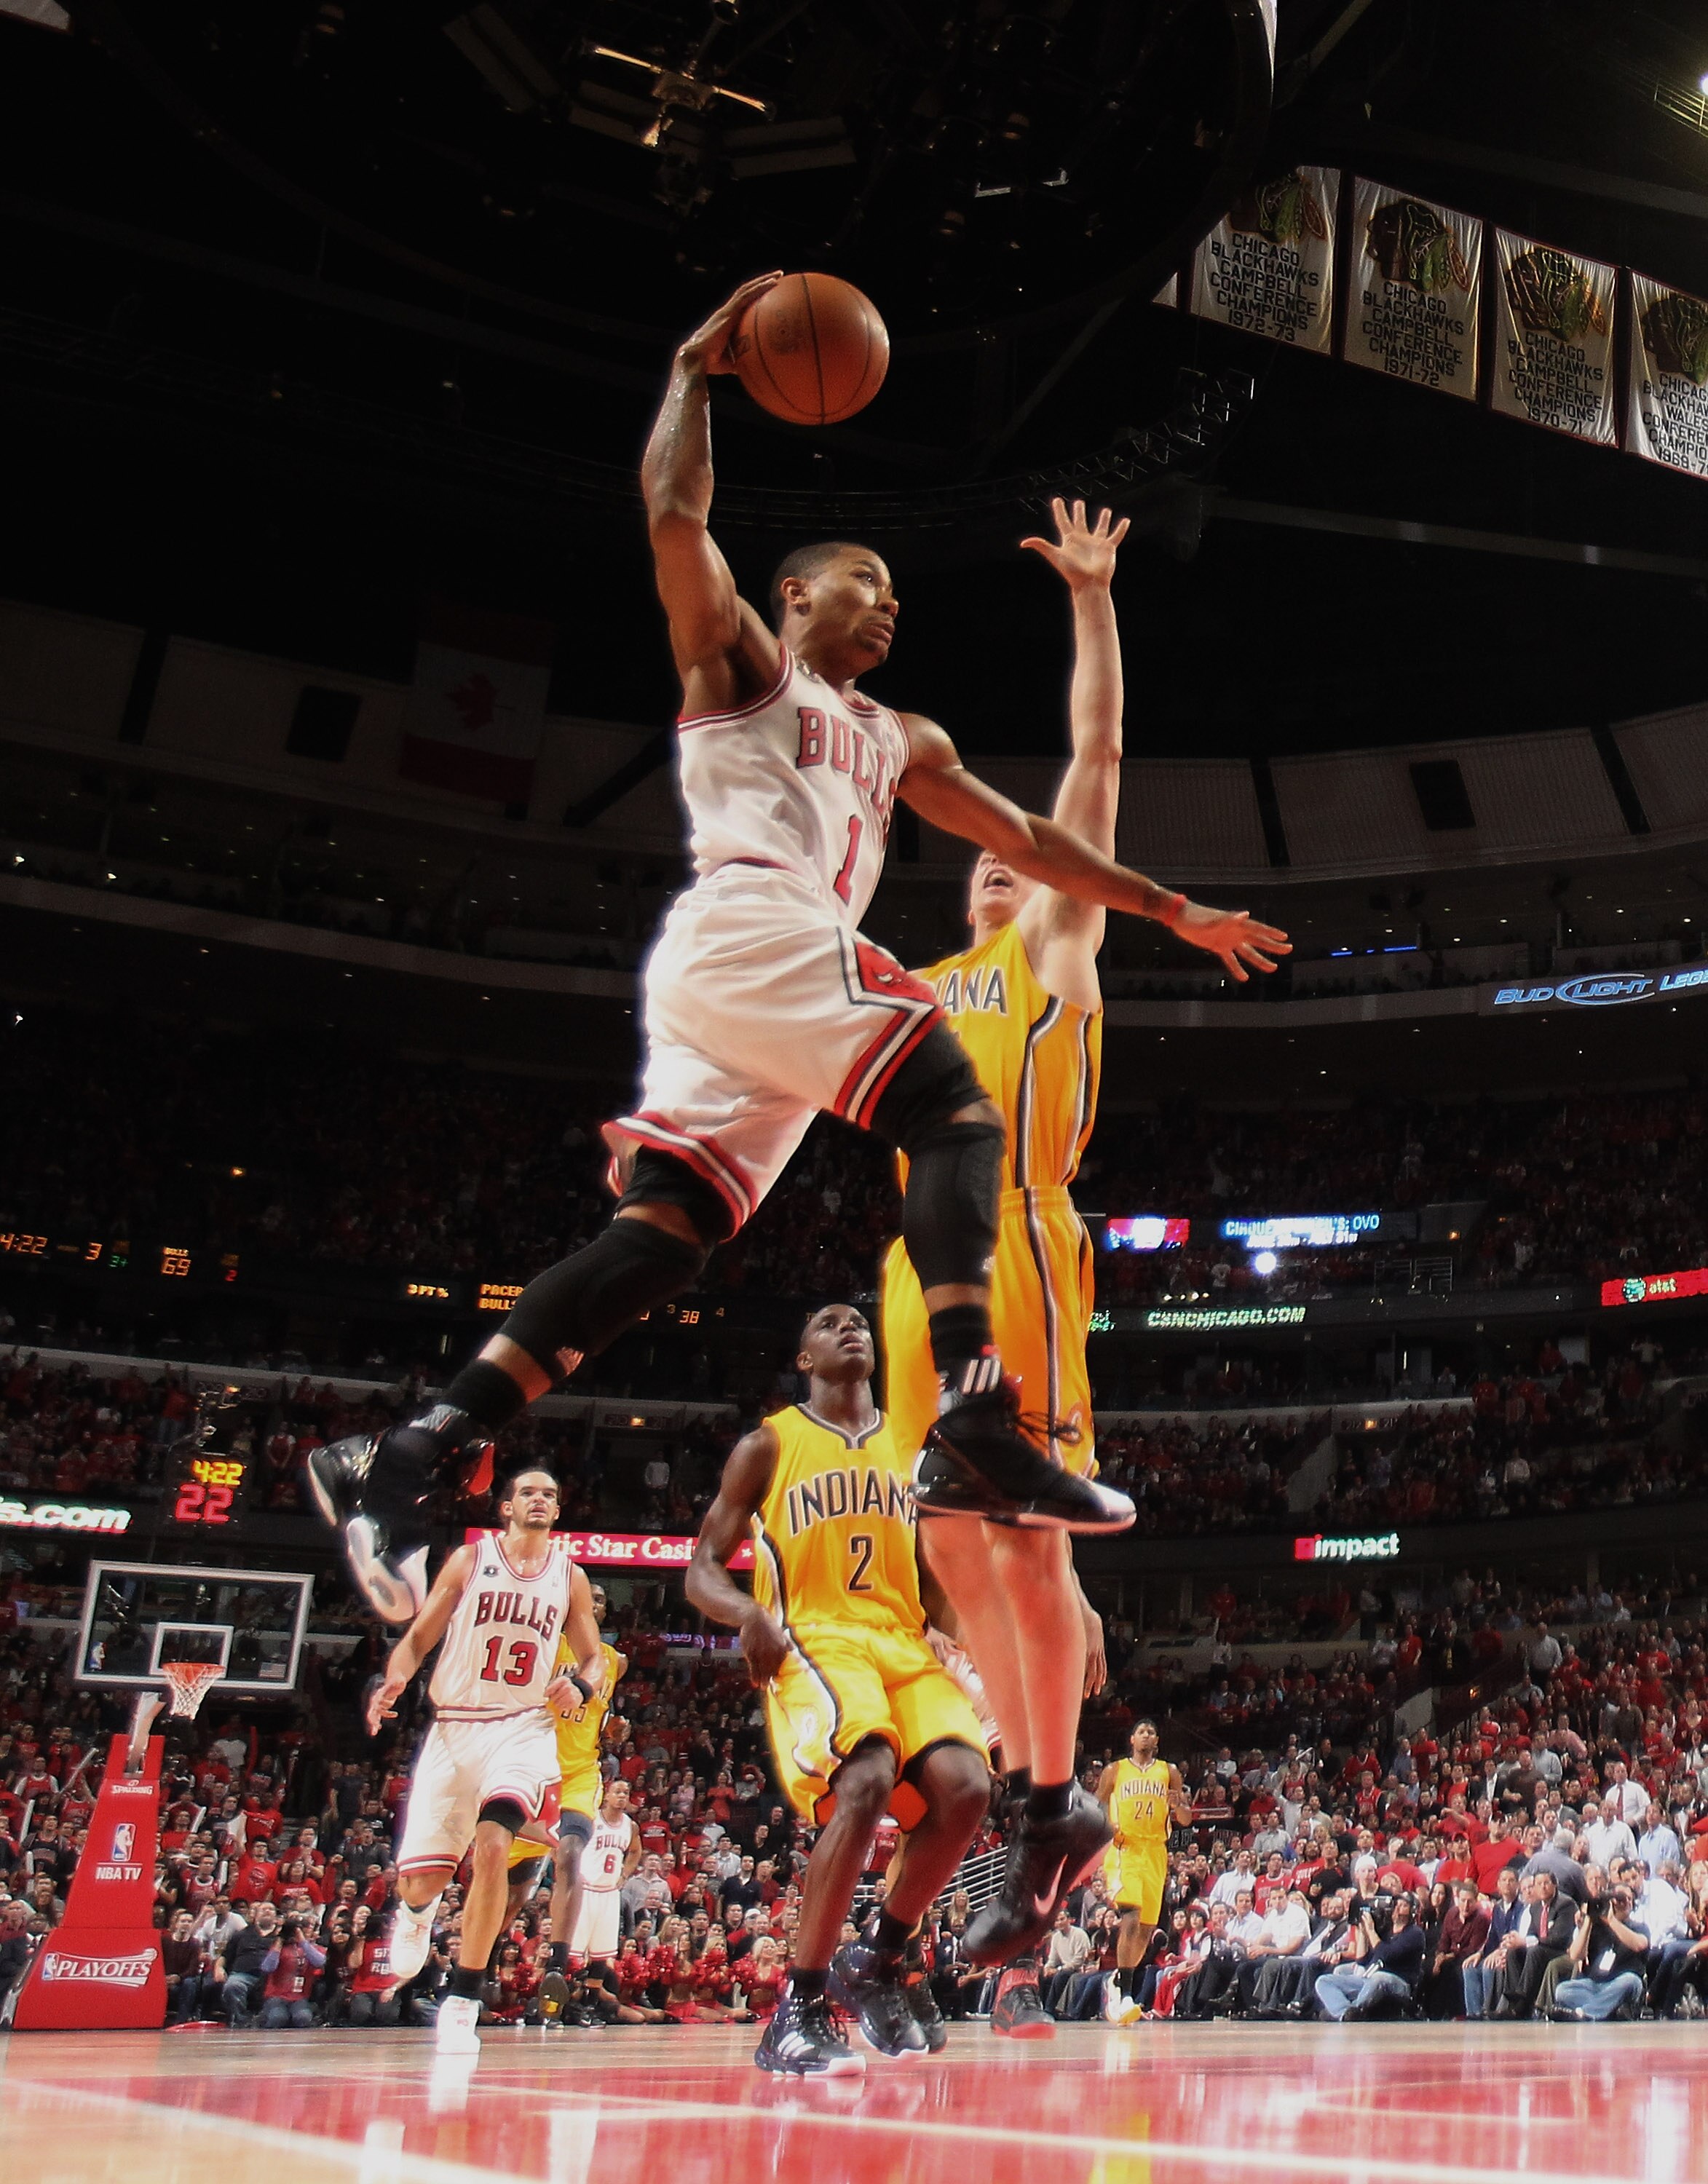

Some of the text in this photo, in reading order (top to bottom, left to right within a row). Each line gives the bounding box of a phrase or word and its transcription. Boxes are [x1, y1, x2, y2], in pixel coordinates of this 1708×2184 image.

[1211, 240, 1319, 286] BLACKHAWKS
[1233, 233, 1300, 266] CHICAGO
[1211, 272, 1317, 316] CONFERENCE
[1221, 259, 1307, 299] CAMPBELL
[1217, 290, 1308, 330] CHAMPIONS
[1364, 290, 1464, 335] BLACKHAWKS
[1384, 281, 1447, 314] CHICAGO
[1229, 309, 1296, 341] 1972-73
[1372, 308, 1455, 347] CAMPBELL
[1363, 321, 1463, 365] CONFERENCE
[1369, 337, 1455, 376] CHAMPIONS
[1526, 331, 1585, 363] CHICAGO
[1385, 357, 1440, 387] 1971-72
[1509, 339, 1603, 381] BLACKHAWKS
[1517, 357, 1593, 393] CAMPBELL
[1509, 369, 1602, 410] CONFERENCE
[1659, 373, 1708, 402] CHICAG
[1514, 387, 1596, 422] CHAMPIONS
[1528, 406, 1582, 435] 1970-71
[1643, 412, 1708, 446] CONFERE
[1649, 429, 1708, 460] CHAMPIO
[833, 813, 863, 908] 1
[1495, 988, 1554, 1005] BUD
[1572, 979, 1653, 998] LIGHT
[1353, 1215, 1380, 1230] OVO
[0, 1233, 48, 1255] 4:22
[84, 1242, 103, 1261] 3
[161, 1257, 191, 1276] 69
[224, 1270, 238, 1282] 2
[480, 1283, 524, 1297] PACER
[680, 1310, 700, 1324] 38
[716, 1307, 725, 1318] 4
[1147, 1307, 1306, 1328] CSNCHICAGO.COM
[192, 1460, 245, 1486] 4:22
[0, 1497, 132, 1530] s.com
[175, 1484, 234, 1523] 22
[588, 1535, 638, 1559] Star
[642, 1536, 696, 1560] Casi
[848, 1534, 874, 1591] 2
[1314, 1532, 1400, 1561] impact
[474, 1591, 558, 1642] BULLS
[480, 1635, 539, 1687] 13
[112, 1785, 154, 1795] SPALDING
[1121, 1780, 1166, 1800] INDIANA
[1134, 1800, 1154, 1820] 24
[96, 1867, 142, 1880] NBA TV
[604, 1853, 617, 1874] 6
[56, 1960, 152, 1977] PLAYOFFS
